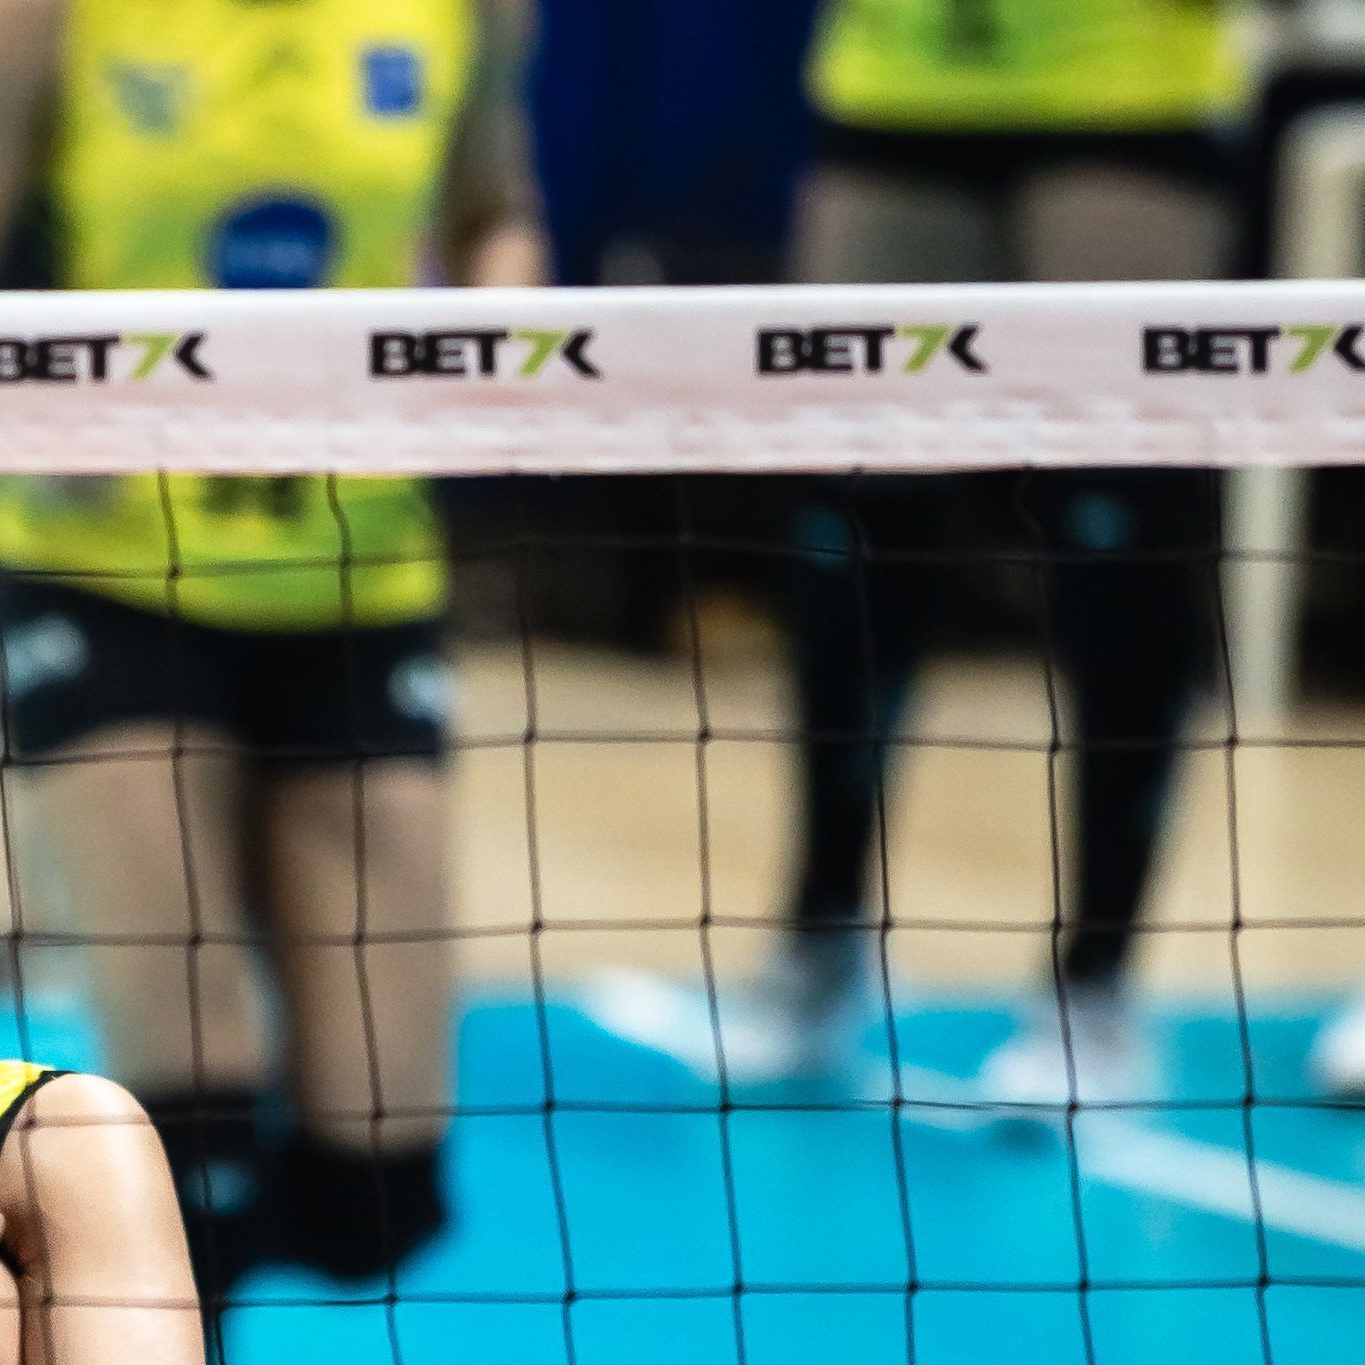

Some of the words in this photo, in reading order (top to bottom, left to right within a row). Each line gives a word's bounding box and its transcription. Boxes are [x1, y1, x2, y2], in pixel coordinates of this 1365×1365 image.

[368, 327, 600, 380] BET7K
[755, 323, 987, 377] BET7K
[1142, 322, 1365, 376] BET7K
